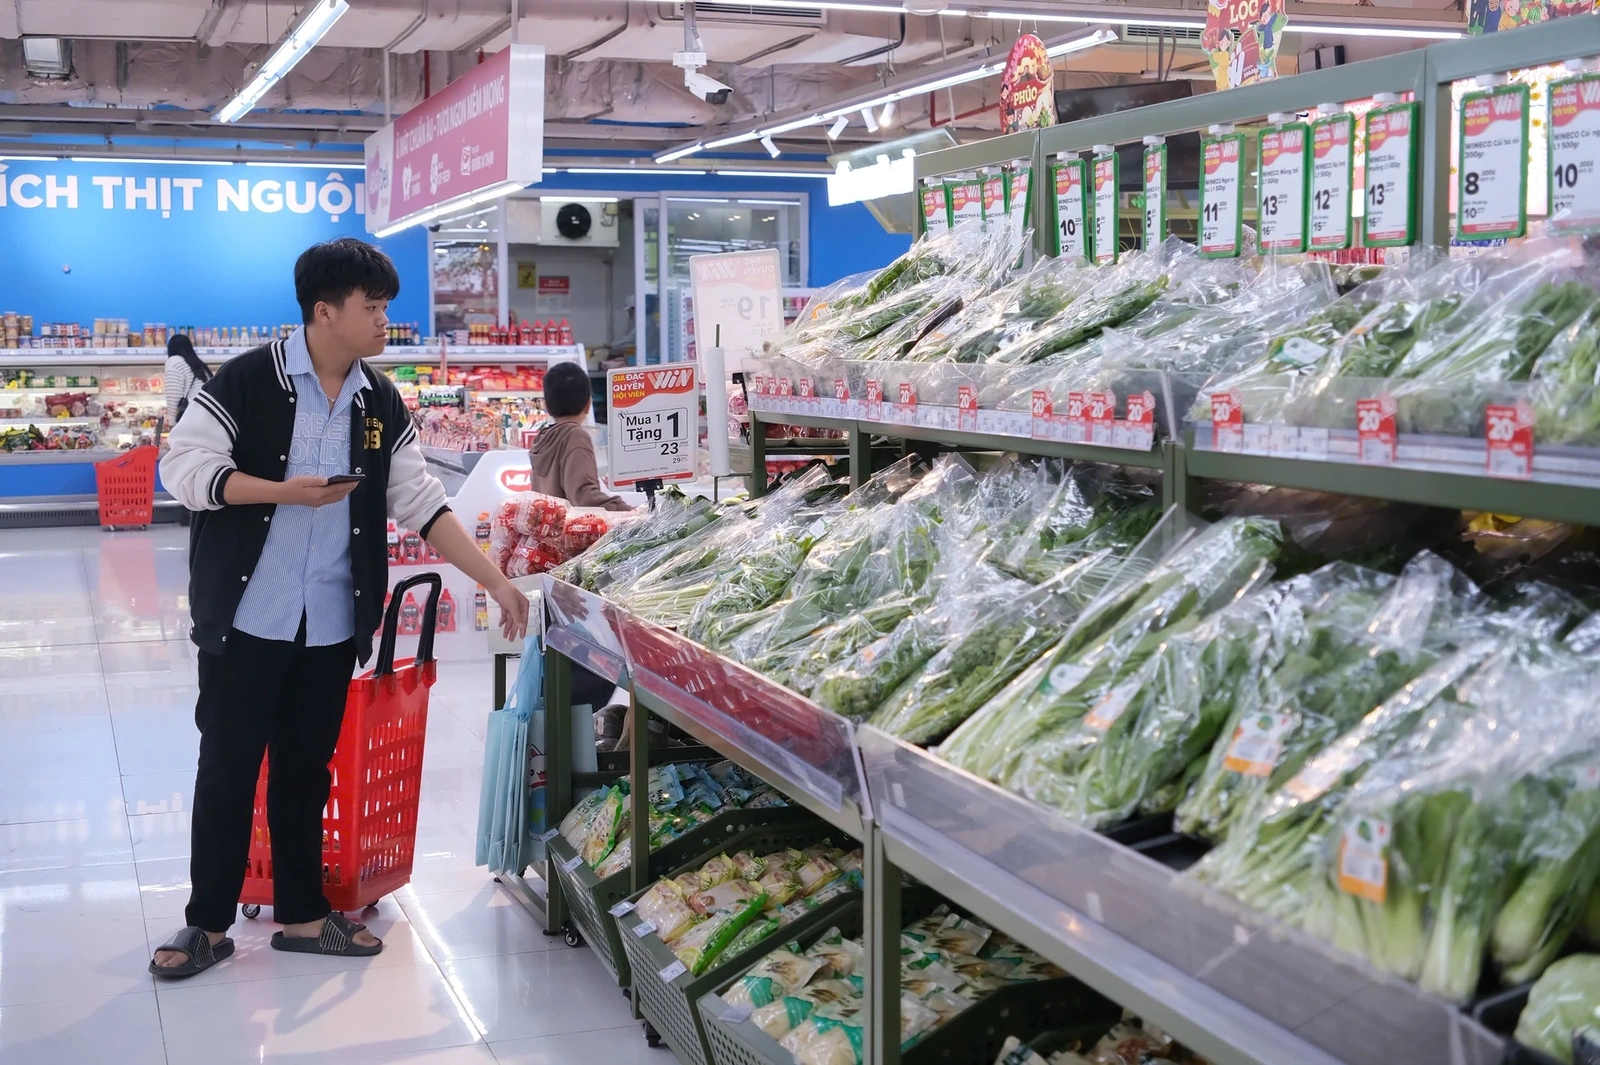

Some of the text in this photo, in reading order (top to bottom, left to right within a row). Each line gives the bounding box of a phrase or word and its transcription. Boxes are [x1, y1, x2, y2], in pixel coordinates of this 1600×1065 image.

[1013, 85, 1038, 106] PHÚC
[1554, 131, 1579, 140] WINECO
[1465, 172, 1479, 195] 8
[1554, 163, 1578, 188] 10
[92, 175, 203, 218] THỊT
[217, 172, 365, 223] NGUỘI
[1315, 189, 1330, 210] 12
[1369, 184, 1385, 205] 13
[1204, 203, 1218, 222] 11
[1263, 195, 1278, 216] 13
[1464, 208, 1476, 218] 10
[1147, 210, 1152, 228] 5
[1060, 219, 1076, 236] 10
[1203, 232, 1211, 240] 14
[613, 382, 645, 392] QUYỀN
[801, 385, 808, 396] 20
[836, 387, 843, 398] 20
[868, 388, 876, 400] 20
[901, 390, 909, 403] 20
[960, 394, 969, 408] 20
[1033, 399, 1044, 413] 20
[1070, 401, 1081, 416] 20
[1091, 402, 1103, 418] 20
[1128, 404, 1142, 421] 20
[1214, 403, 1230, 421] 20
[626, 414, 660, 426] Mua 1
[667, 412, 679, 438] 1
[1359, 410, 1380, 431] 20
[627, 427, 662, 442] Tặng
[1488, 417, 1514, 441] 20
[660, 442, 679, 456] 23
